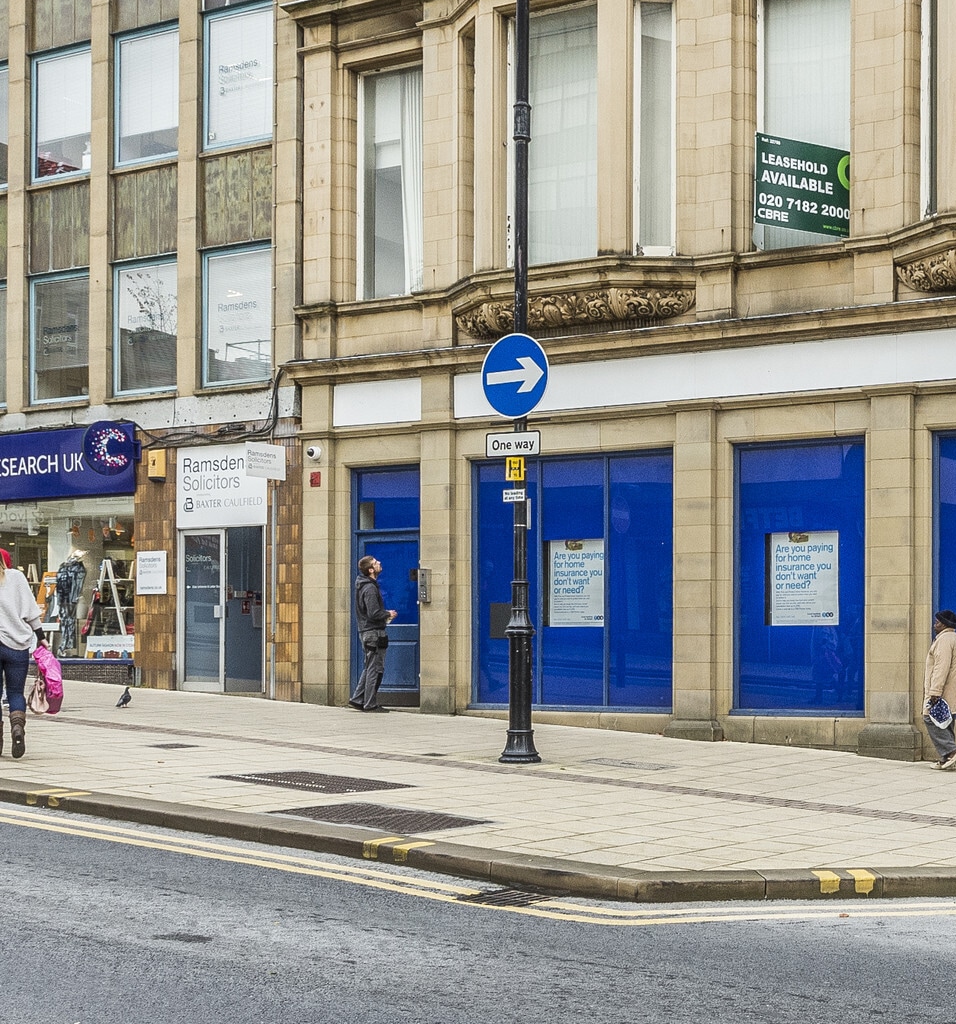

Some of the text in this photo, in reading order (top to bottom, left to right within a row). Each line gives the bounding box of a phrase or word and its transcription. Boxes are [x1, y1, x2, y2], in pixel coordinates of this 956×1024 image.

[218, 59, 259, 73] Ramsdens
[761, 152, 828, 175] LEASEHOLD
[761, 170, 834, 195] AVAILABLE
[759, 193, 850, 220] 020 7182 2000
[757, 208, 789, 222] CBRE
[217, 301, 257, 312] Ramsdens
[492, 440, 535, 451] One way
[0, 453, 84, 477] SEARCH UK
[183, 455, 246, 473] Ramsden
[183, 474, 241, 492] Solicitors
[196, 498, 222, 509] BAXTER
[223, 496, 263, 508] CAULFIELD
[775, 543, 834, 554] Are you paying
[185, 554, 212, 563] Solicitors
[554, 551, 604, 562] Are you paying
[775, 553, 811, 562] for home
[775, 563, 832, 572] insurance you
[554, 569, 602, 578] insurance you
[775, 572, 817, 581] don't want
[554, 578, 571, 586] don't
[785, 580, 811, 590] need?
[562, 585, 584, 594] need?
